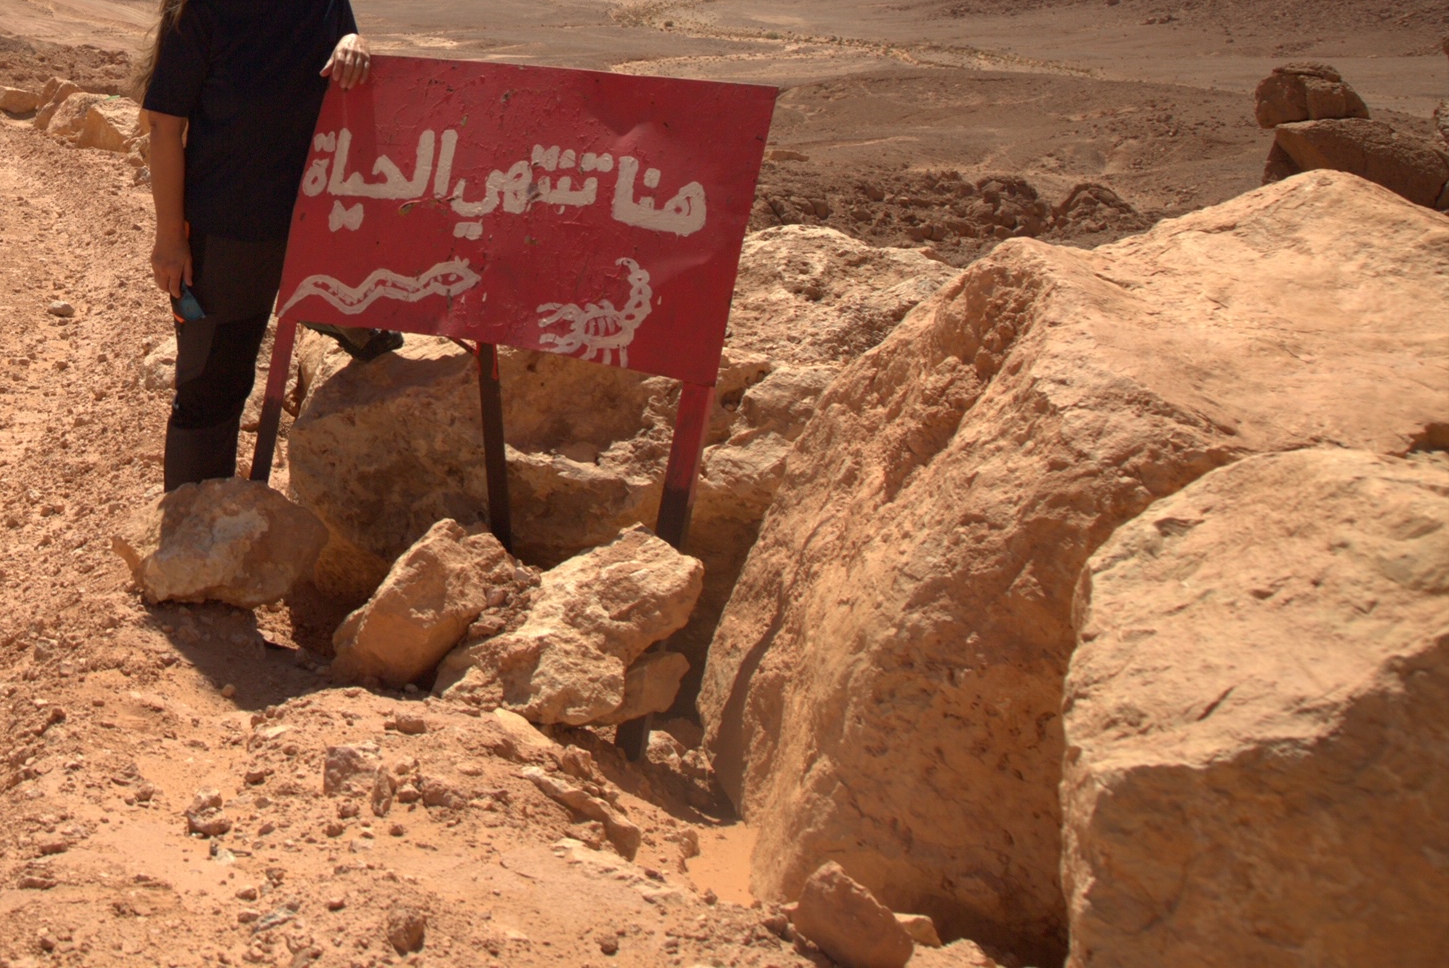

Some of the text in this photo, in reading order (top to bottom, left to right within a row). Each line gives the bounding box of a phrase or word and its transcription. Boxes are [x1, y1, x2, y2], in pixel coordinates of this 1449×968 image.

[302, 127, 707, 241] هنا تنتهي الحياة
